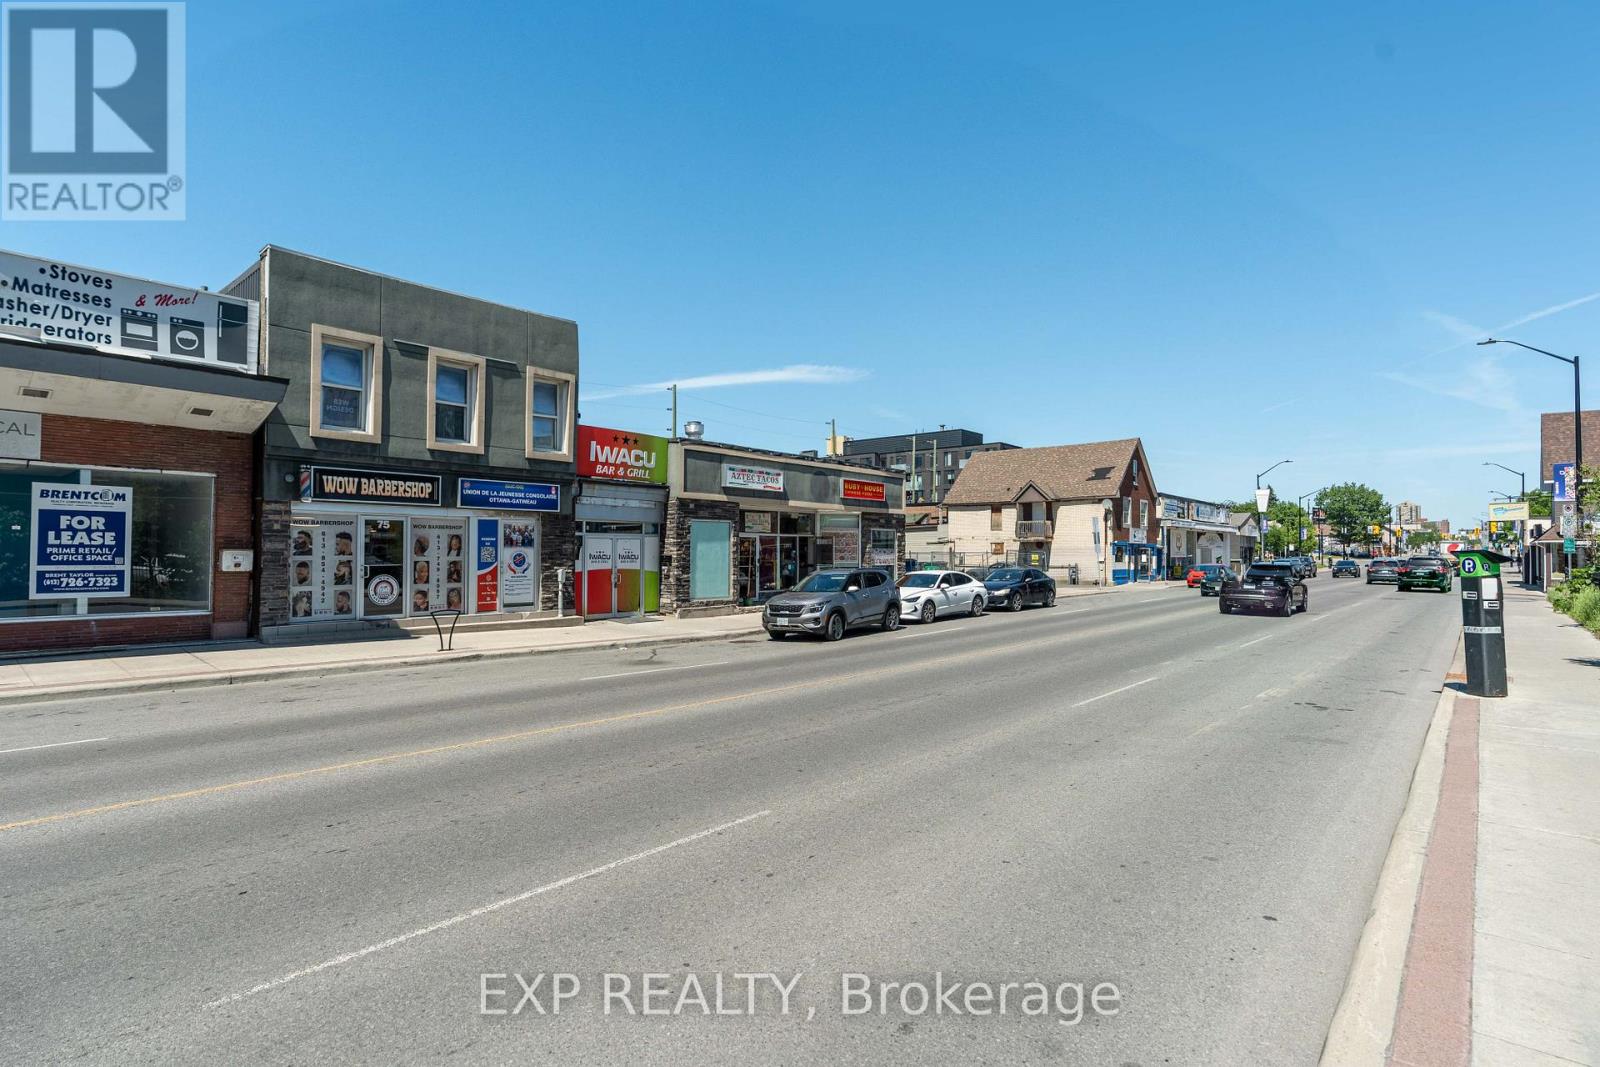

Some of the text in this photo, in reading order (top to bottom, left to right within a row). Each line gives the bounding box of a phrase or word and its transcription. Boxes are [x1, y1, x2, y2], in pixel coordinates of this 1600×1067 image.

[49, 264, 113, 290] Stoves
[11, 276, 112, 309] Matresses
[135, 290, 198, 307] & More!
[589, 440, 656, 469] IWACU
[595, 464, 651, 479] BAR & GRILL
[322, 475, 433, 499] WOW BARBERSHOP
[864, 484, 884, 493] HOUSE
[60, 515, 106, 530] FOR
[377, 521, 390, 529] 75
[47, 531, 116, 545] LEASE
